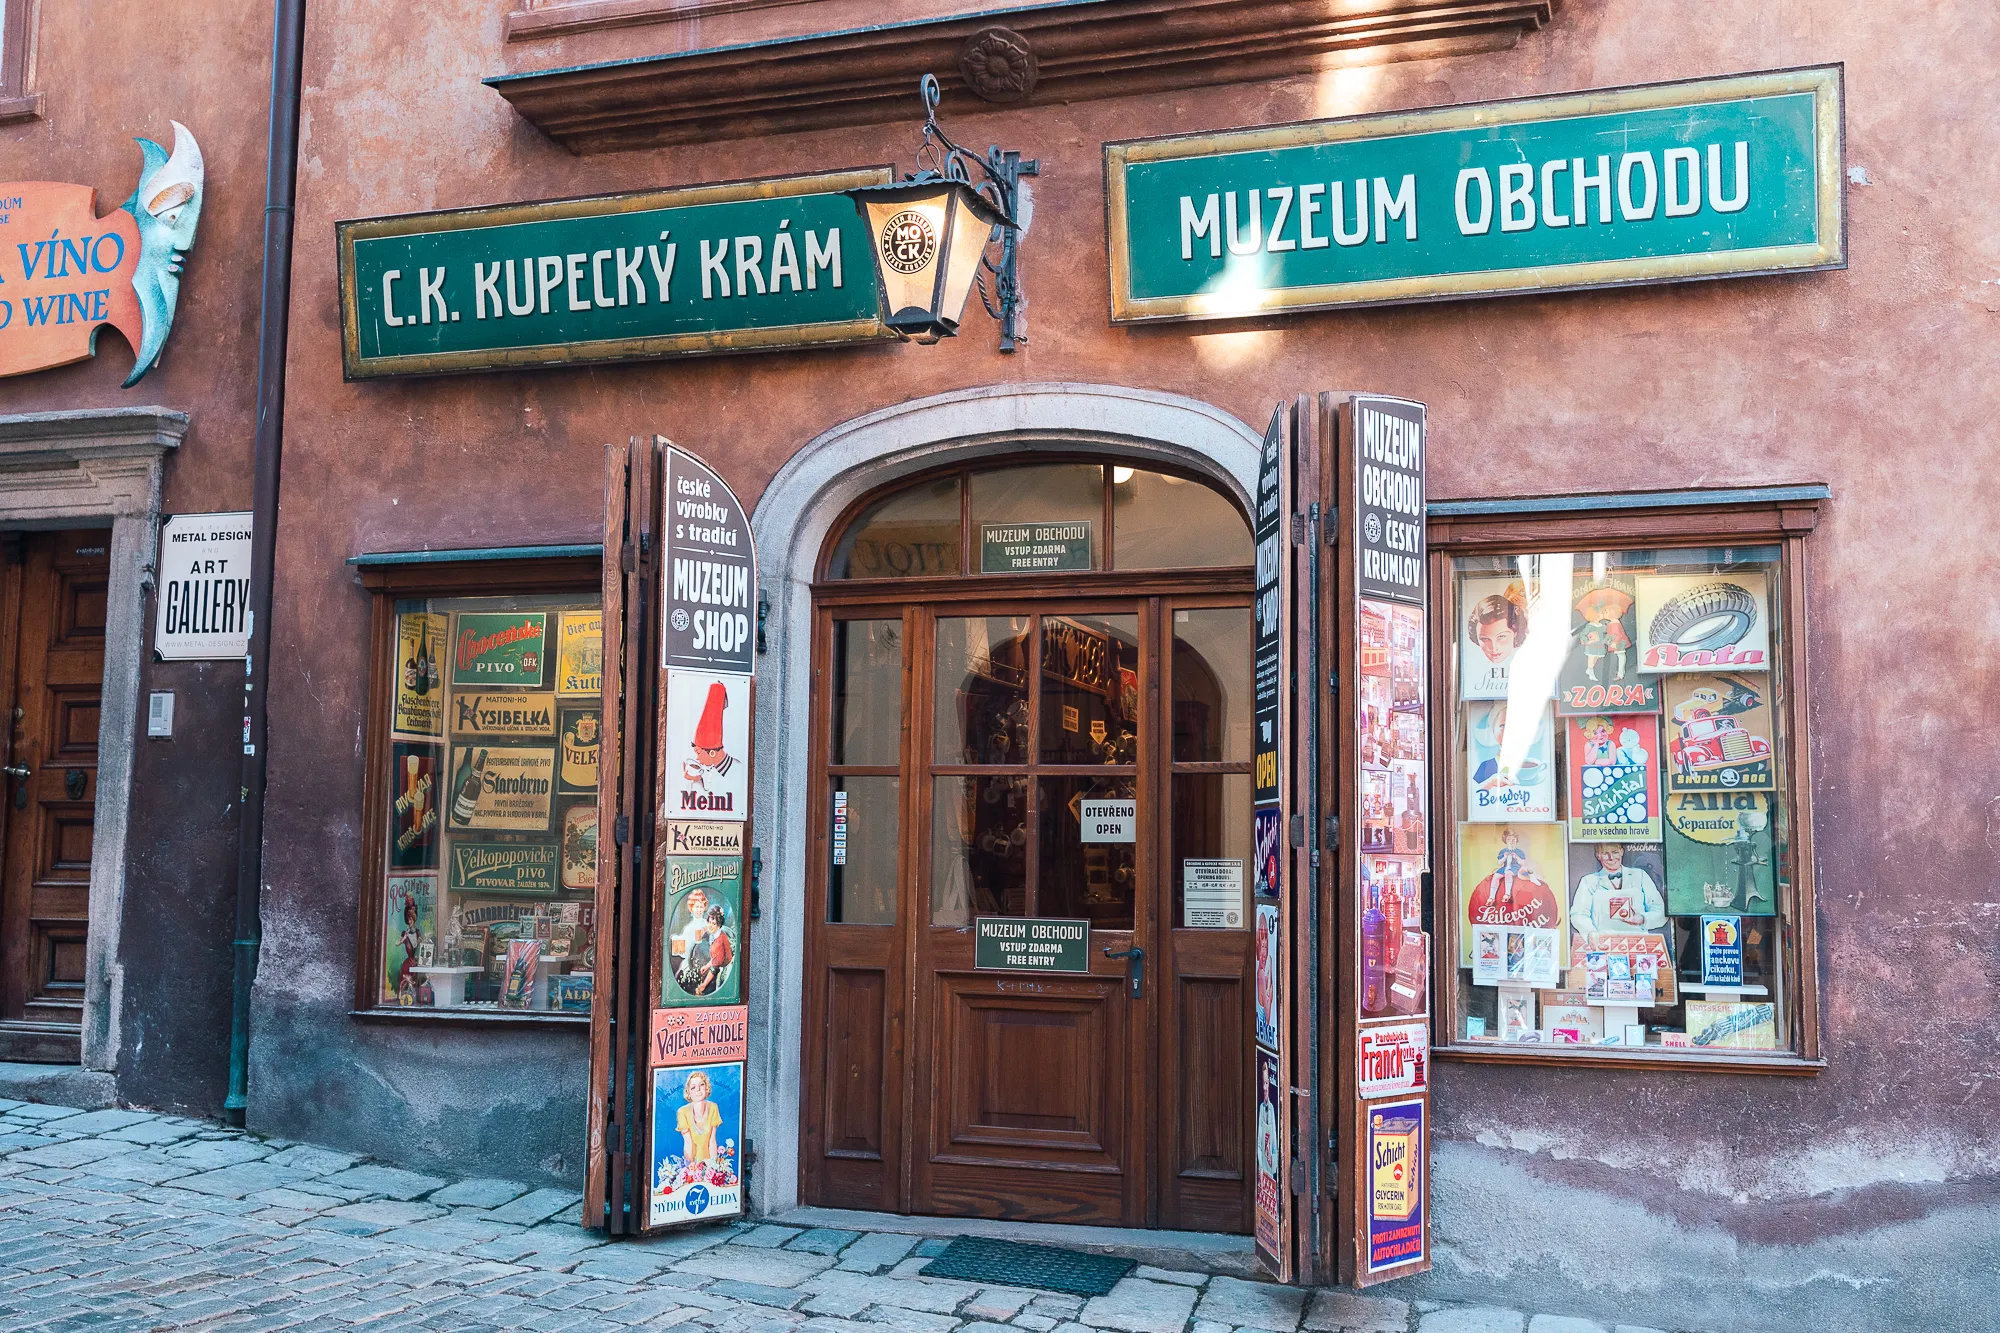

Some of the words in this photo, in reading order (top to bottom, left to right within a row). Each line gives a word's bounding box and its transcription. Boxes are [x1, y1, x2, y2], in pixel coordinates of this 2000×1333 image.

[1180, 173, 1418, 261] MUZEUM
[1454, 140, 1750, 235] OBCHODU
[896, 225, 921, 241] MO
[17, 228, 125, 281] VÍNO
[896, 241, 921, 260] ČK
[382, 265, 461, 327] C.K.
[474, 230, 678, 320] KUPECKÝ
[700, 219, 843, 299] KRÁM
[22, 288, 110, 327] WINE
[1363, 407, 1420, 472] MUZEUM
[677, 475, 711, 498] české
[1363, 464, 1420, 517] OBCHODU
[676, 500, 728, 524] výrobky
[172, 532, 207, 543] METAL
[210, 531, 252, 541] DESIGN
[676, 524, 684, 539] s
[689, 523, 738, 547] tradicí
[986, 528, 1030, 543] MUZEUM
[1035, 526, 1086, 541] OBCHODU
[1386, 513, 1421, 554] ČESKÝ
[1004, 545, 1032, 556] VSTUP
[1032, 544, 1067, 555] ZDARMA
[1256, 530, 1278, 591] MUZEUM
[190, 559, 228, 574] ART
[1011, 557, 1032, 568] FREE
[1032, 556, 1059, 567] ENTRY
[1364, 548, 1421, 588] KRUMLOV
[673, 558, 749, 608] MUZEUM
[165, 578, 250, 635] GALLERY
[1262, 585, 1278, 638] SHOP
[692, 609, 749, 653] SHOP
[164, 640, 246, 648] WWW.METAL-DESIGN.CZ
[475, 662, 515, 673] PIVO
[457, 696, 551, 731] KYSIBELKA
[540, 758, 551, 767] PIVO
[564, 745, 600, 765] VELK
[1256, 750, 1276, 790] OPEN
[395, 773, 432, 814] PIVVAR
[482, 770, 549, 796] Starobrno
[680, 790, 734, 812] Meinl
[1085, 804, 1134, 818] OTEVŘENO
[397, 807, 437, 851] KRUŠVICE
[671, 825, 740, 851] KYSIBELKA
[1096, 823, 1122, 835] OPEN
[1582, 828, 1598, 837] pere
[1599, 825, 1628, 836] všechno
[1629, 825, 1650, 836] hravě
[475, 877, 516, 888] PIVOVAR
[517, 865, 546, 880] pivo
[981, 924, 1026, 938] MUZEUM
[1031, 925, 1083, 940] OBCHODU
[1000, 942, 1027, 953] VSTUP
[1028, 943, 1063, 954] ZDARMA
[1006, 954, 1027, 965] FREE
[1028, 955, 1056, 966] ENTRY
[656, 1023, 705, 1061] VAJEČNÉ
[708, 1022, 745, 1044] NUDLE
[681, 1050, 688, 1058] A
[690, 1045, 743, 1057] MAKARONY.
[1665, 1040, 1687, 1048] SHELL
[1375, 1141, 1406, 1170] Schicht
[654, 1200, 685, 1213] MÝDLO
[710, 1192, 738, 1206] ELIDA
[1375, 1189, 1405, 1201] GLYCERIN
[1372, 1231, 1388, 1245] PROTI
